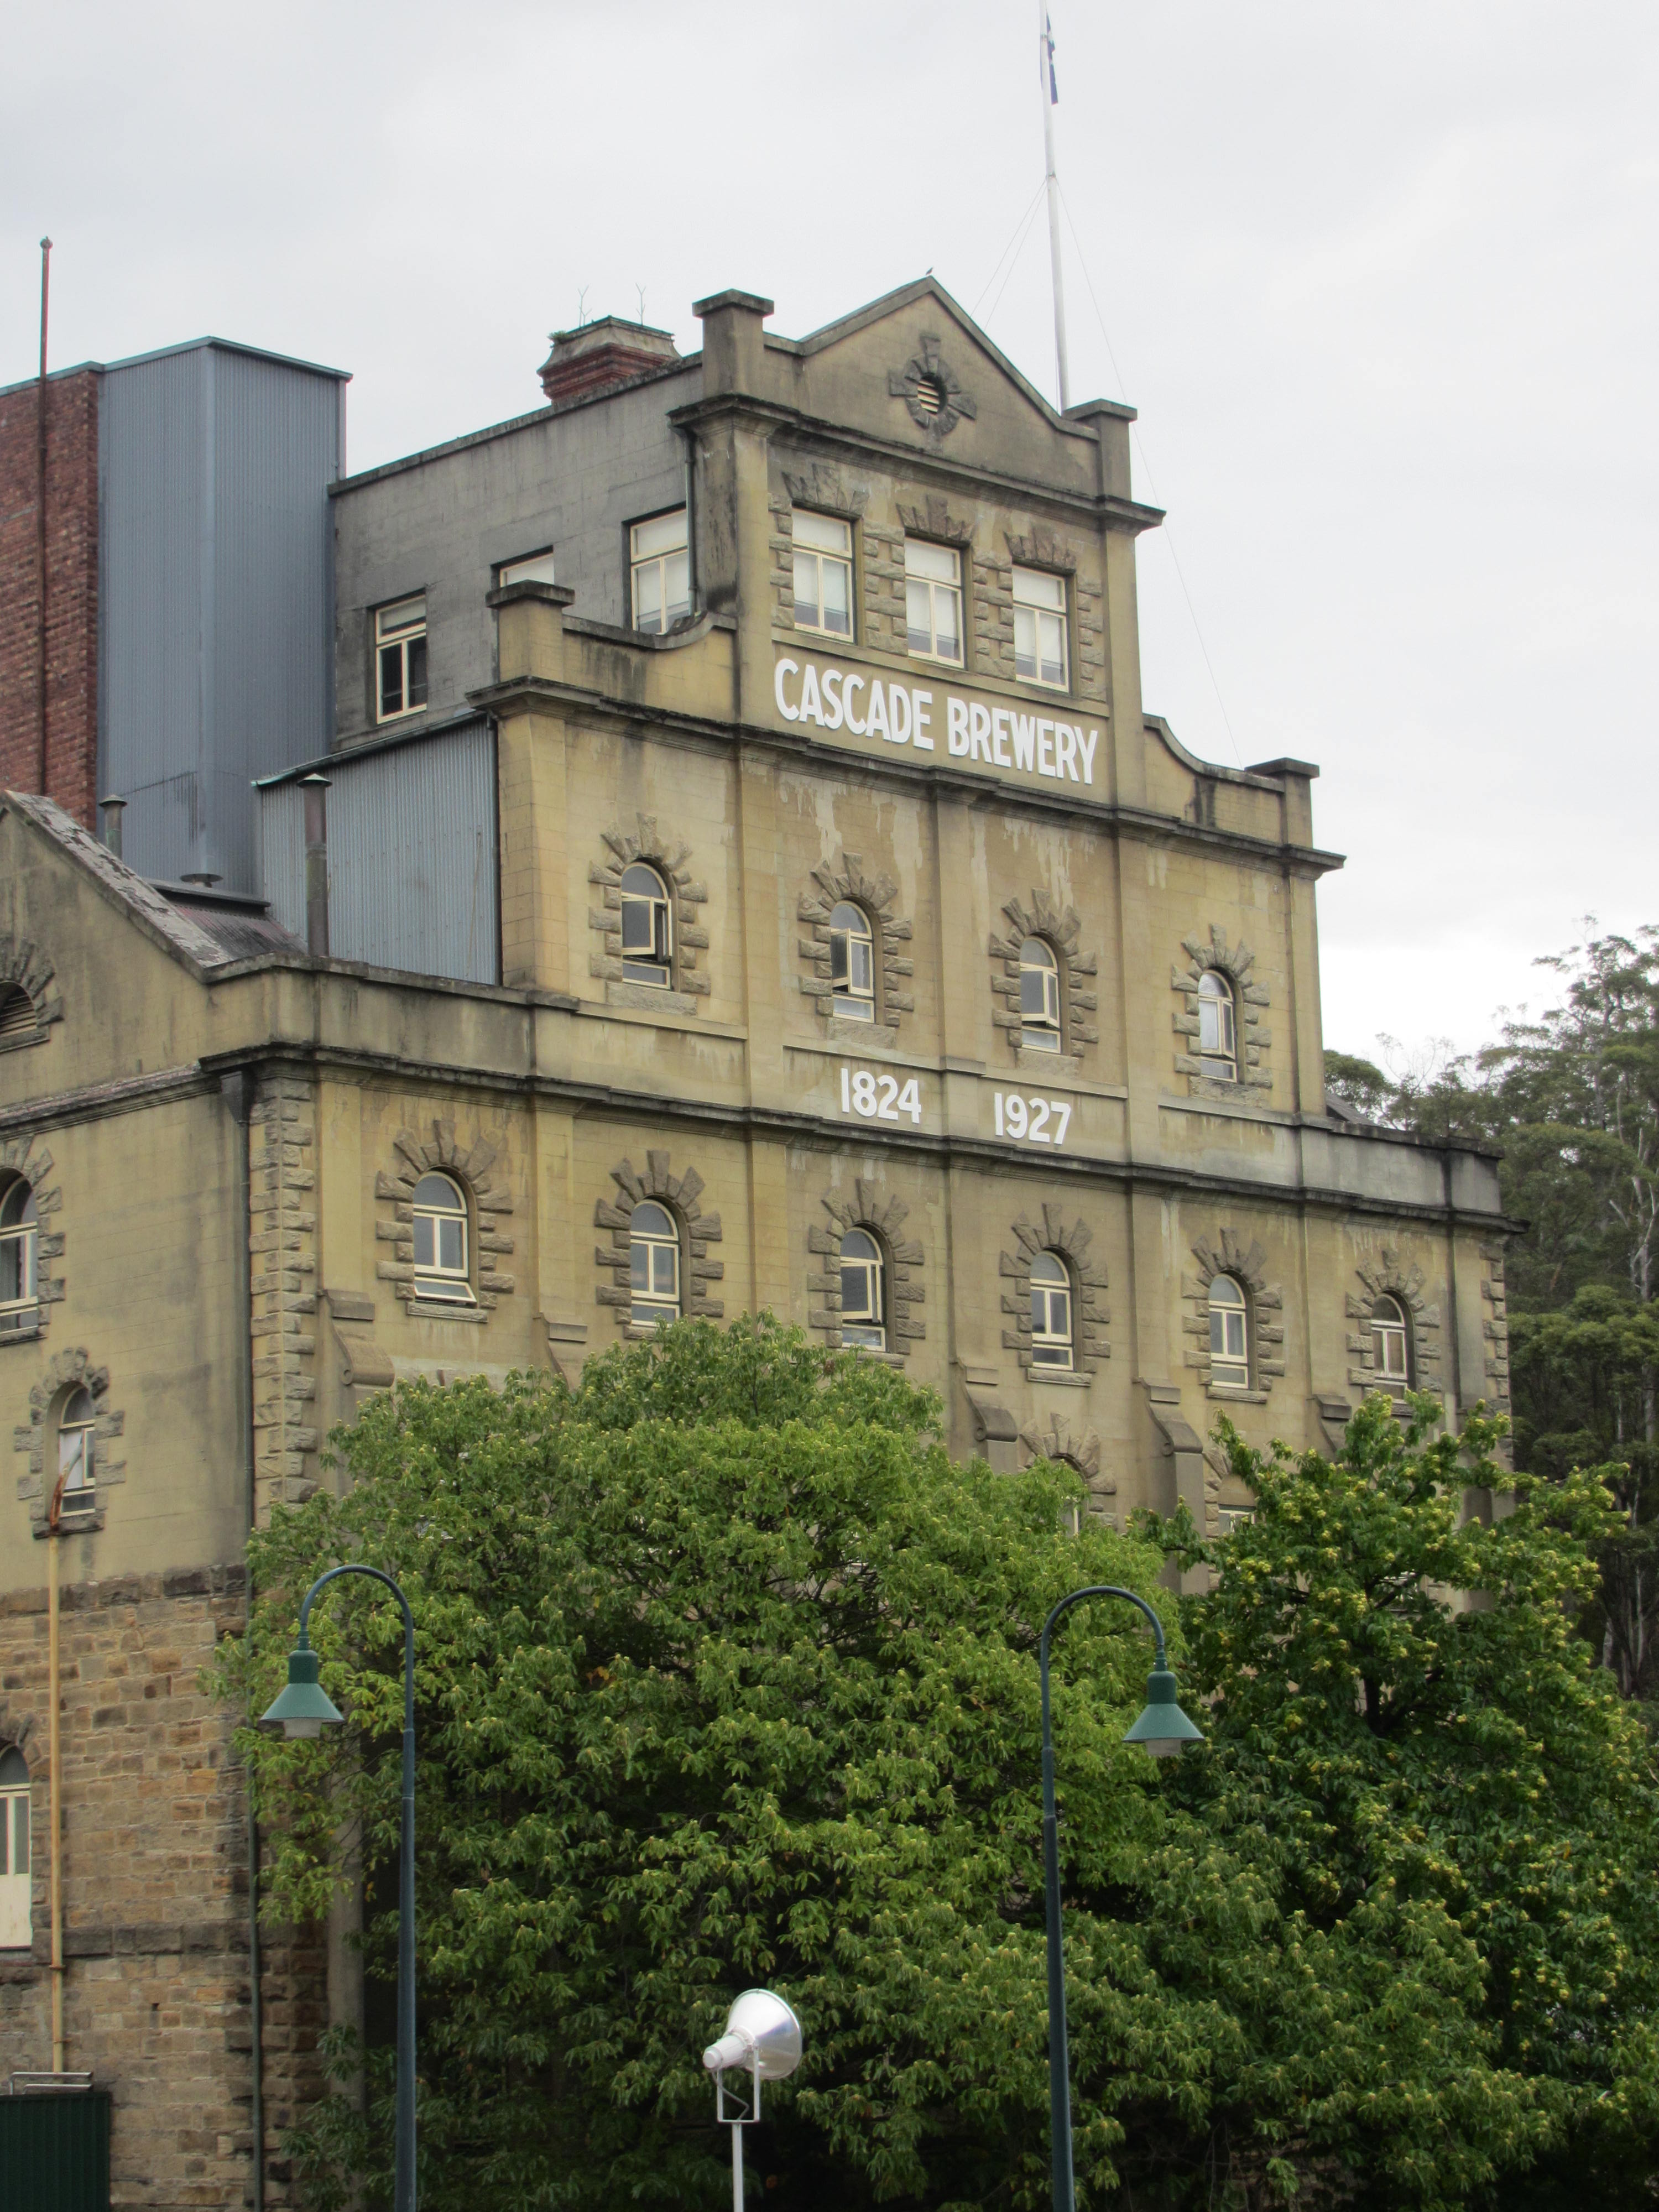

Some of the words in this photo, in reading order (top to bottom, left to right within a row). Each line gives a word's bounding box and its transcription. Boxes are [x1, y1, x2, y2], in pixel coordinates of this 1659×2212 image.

[775, 658, 934, 750] CASCADE
[947, 697, 1098, 784] BREWERY
[841, 1068, 922, 1124] 1824
[994, 1092, 1072, 1145] 1927
